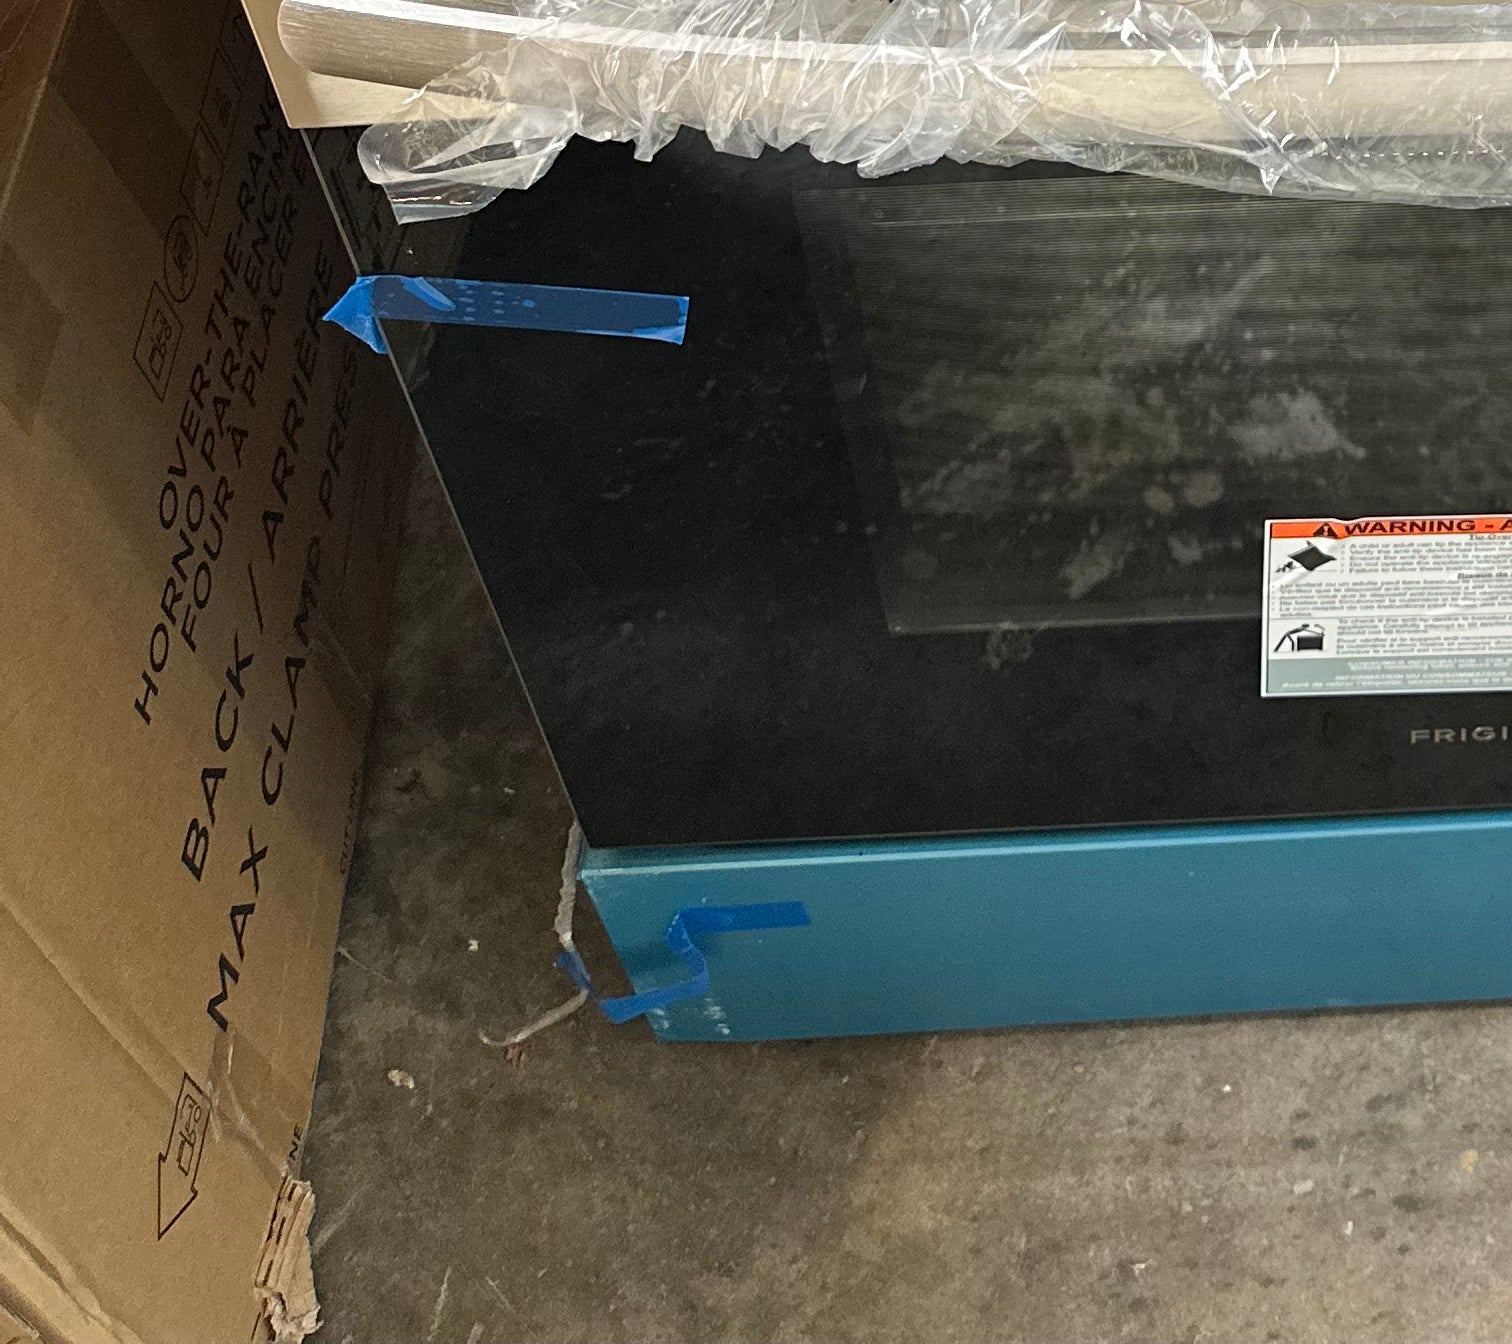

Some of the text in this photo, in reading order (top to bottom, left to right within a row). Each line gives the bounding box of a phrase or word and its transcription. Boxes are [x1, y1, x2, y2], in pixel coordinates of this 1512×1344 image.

[134, 318, 250, 725] HORNO PARA
[181, 193, 297, 653] FOUR PLACER
[181, 241, 333, 882] BACK ARRIÈRE
[1345, 520, 1477, 534] WARNING
[207, 823, 269, 1032] MAX
[262, 535, 321, 805] CLAMP
